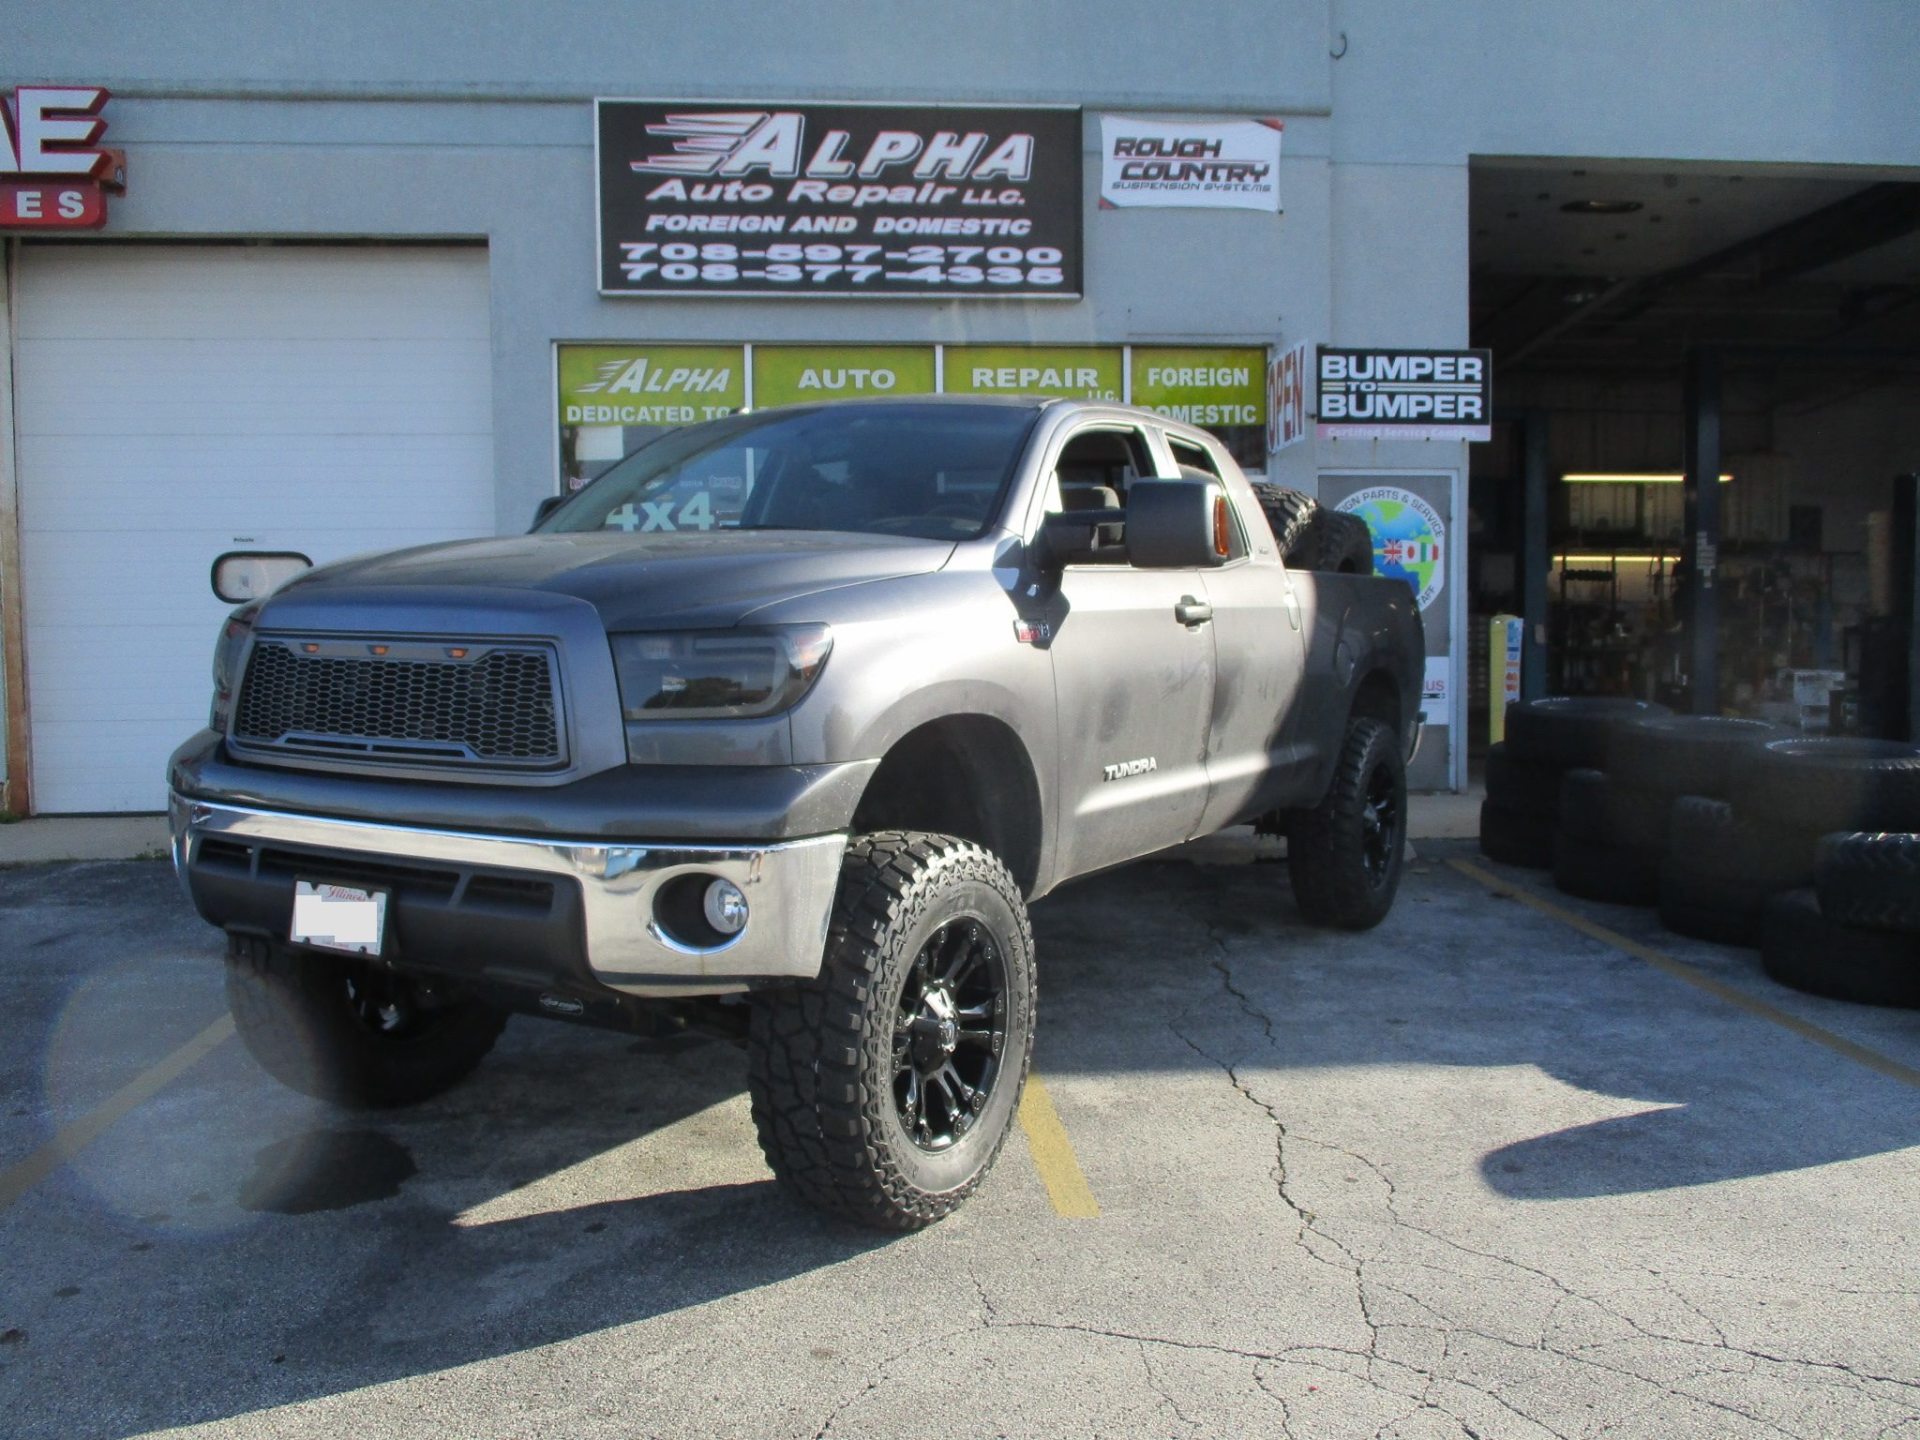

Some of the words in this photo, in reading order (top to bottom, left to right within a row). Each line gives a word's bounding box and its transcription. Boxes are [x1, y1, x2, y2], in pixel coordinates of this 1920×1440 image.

[720, 112, 1035, 180] ALPHA
[1114, 136, 1222, 158] ROUGH
[1120, 161, 1270, 183] COUNTRY
[645, 178, 774, 202] Auto
[787, 179, 957, 207] Repair
[1111, 180, 1200, 190] SUSPENSION
[1203, 182, 1272, 192] SYSTEMS
[646, 214, 786, 232] FOREIGN
[789, 216, 858, 233] AND
[873, 217, 1032, 236] DOMESTIC
[620, 242, 1064, 264] 708-597-2700
[607, 358, 730, 393] ALPHA
[798, 368, 896, 389] AUTO
[972, 367, 1099, 388] REPAIR
[1147, 367, 1249, 387] FOREIGN
[1321, 355, 1483, 381] BUMPER
[1268, 345, 1304, 450] OPEN
[1346, 381, 1377, 392] TO
[566, 404, 695, 423] DEDICATED
[1321, 394, 1483, 419] BUMPER
[1362, 489, 1400, 502] PARTS
[1410, 498, 1444, 537] SERVICE
[1104, 757, 1157, 781] TUNDRA
